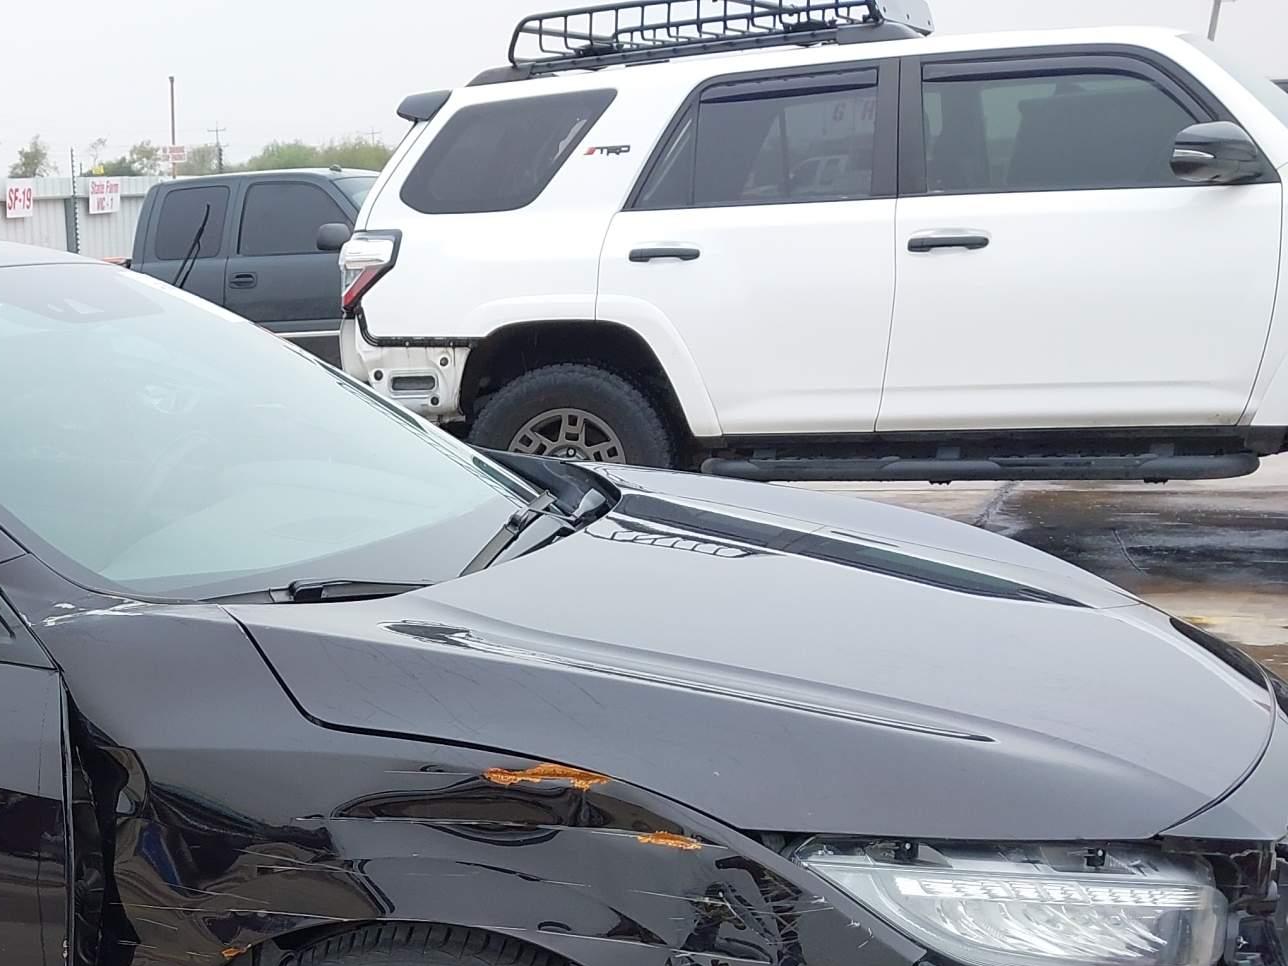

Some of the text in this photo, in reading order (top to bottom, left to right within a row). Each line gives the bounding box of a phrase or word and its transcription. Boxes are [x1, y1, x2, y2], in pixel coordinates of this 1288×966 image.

[592, 144, 631, 156] TRD
[91, 180, 120, 195] State Farm
[8, 188, 32, 210] SF-19
